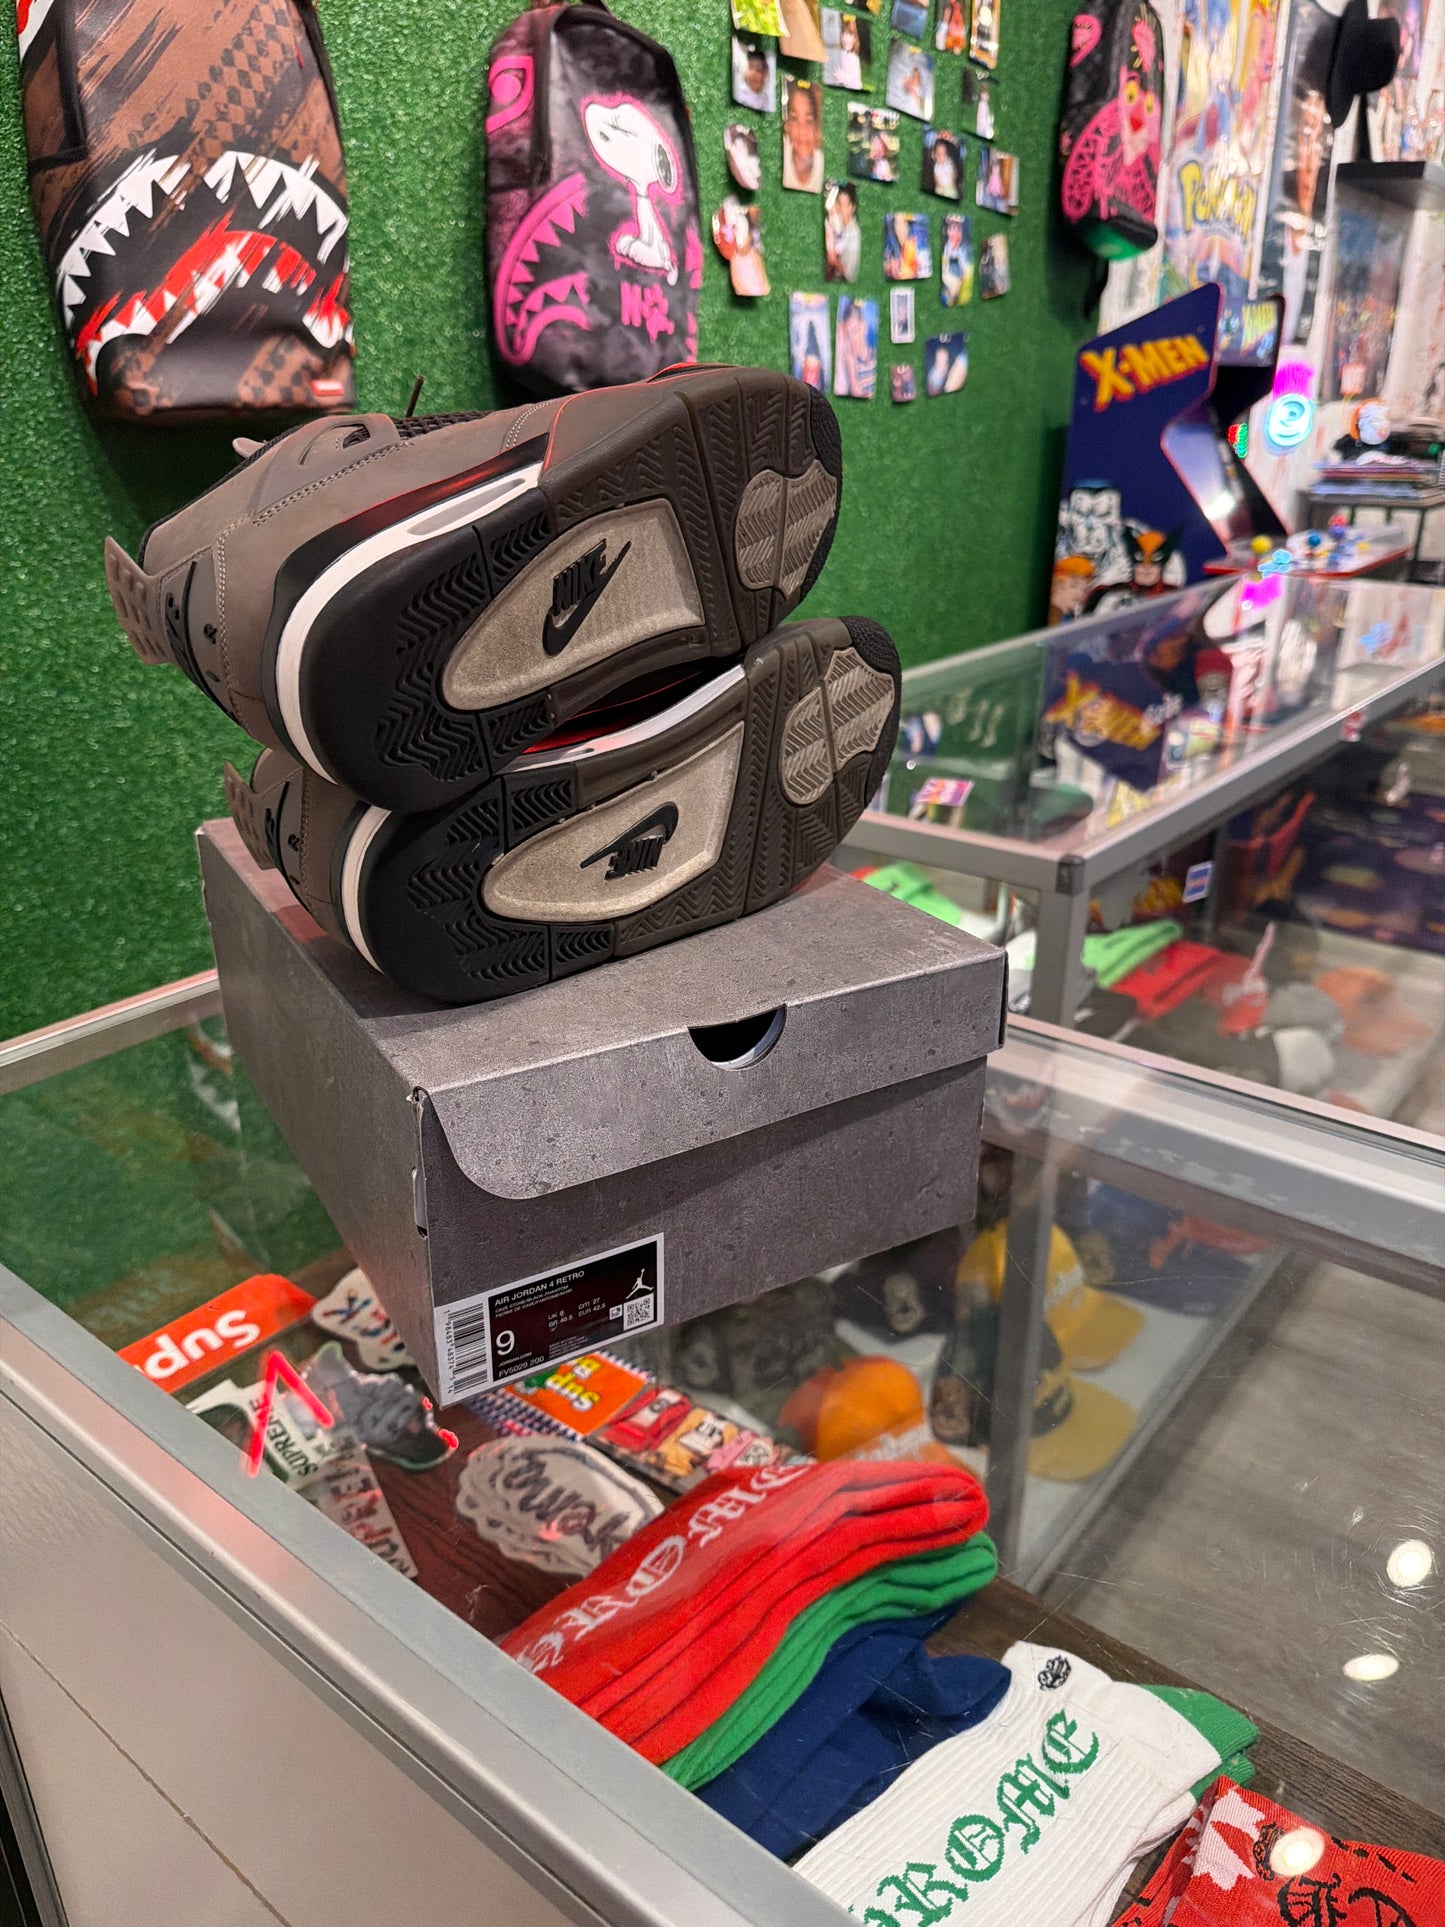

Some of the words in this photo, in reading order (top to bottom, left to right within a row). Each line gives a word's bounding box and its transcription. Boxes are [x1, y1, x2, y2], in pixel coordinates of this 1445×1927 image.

[1079, 334, 1209, 413] X-MEN
[552, 538, 607, 616] NIKE
[604, 834, 664, 880] NIKE
[494, 1295, 510, 1307] AIR
[511, 1283, 547, 1301] JORDAN
[556, 1270, 585, 1285] RETRO
[134, 1310, 261, 1379] Sup
[495, 1329, 515, 1356] 9
[498, 1361, 528, 1378] FV5029
[529, 1355, 545, 1367] 200
